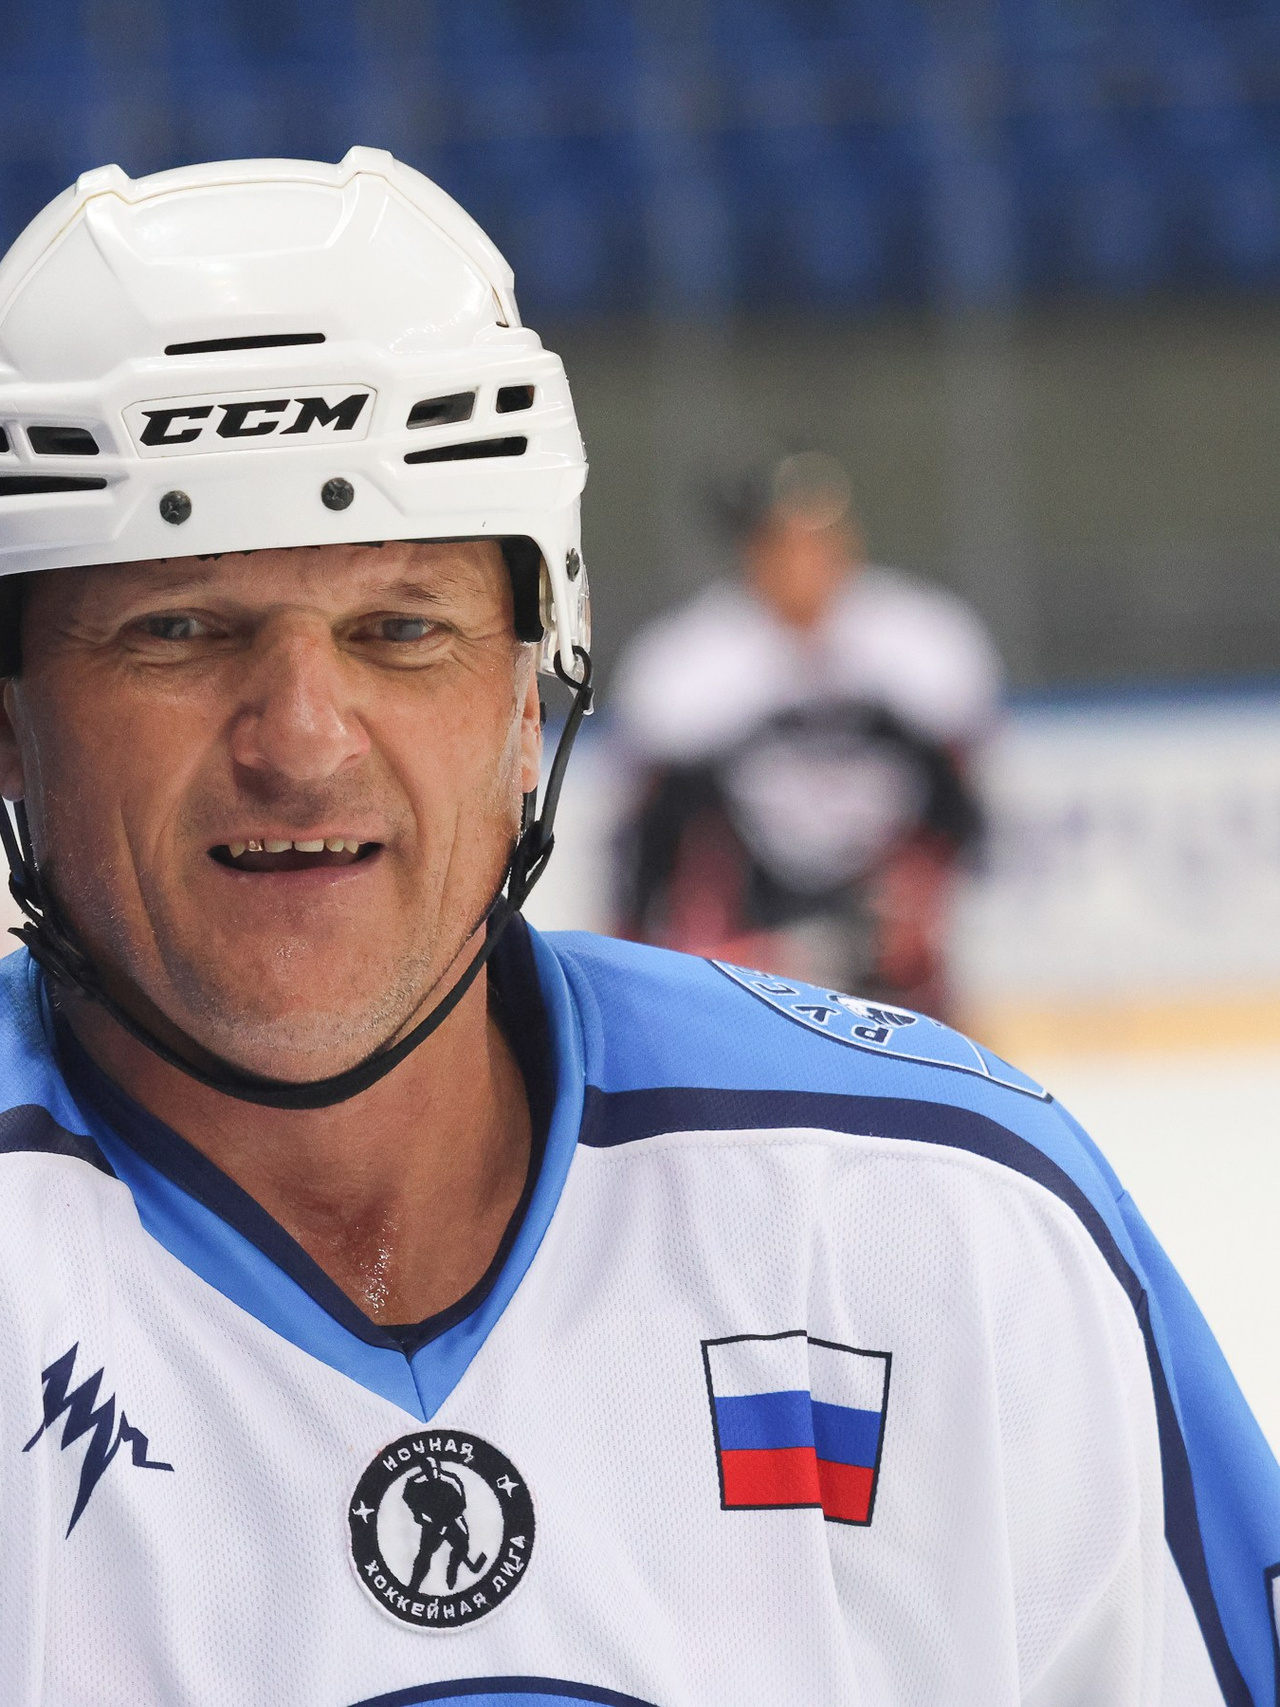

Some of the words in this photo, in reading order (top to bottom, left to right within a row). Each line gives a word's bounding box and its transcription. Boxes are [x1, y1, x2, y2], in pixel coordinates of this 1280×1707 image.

[139, 393, 370, 447] CCM
[382, 1437, 474, 1472] НОЧНАЯ
[364, 1559, 488, 1620] ХОККЕЙНАЯ
[491, 1535, 527, 1593] ЛИГА
